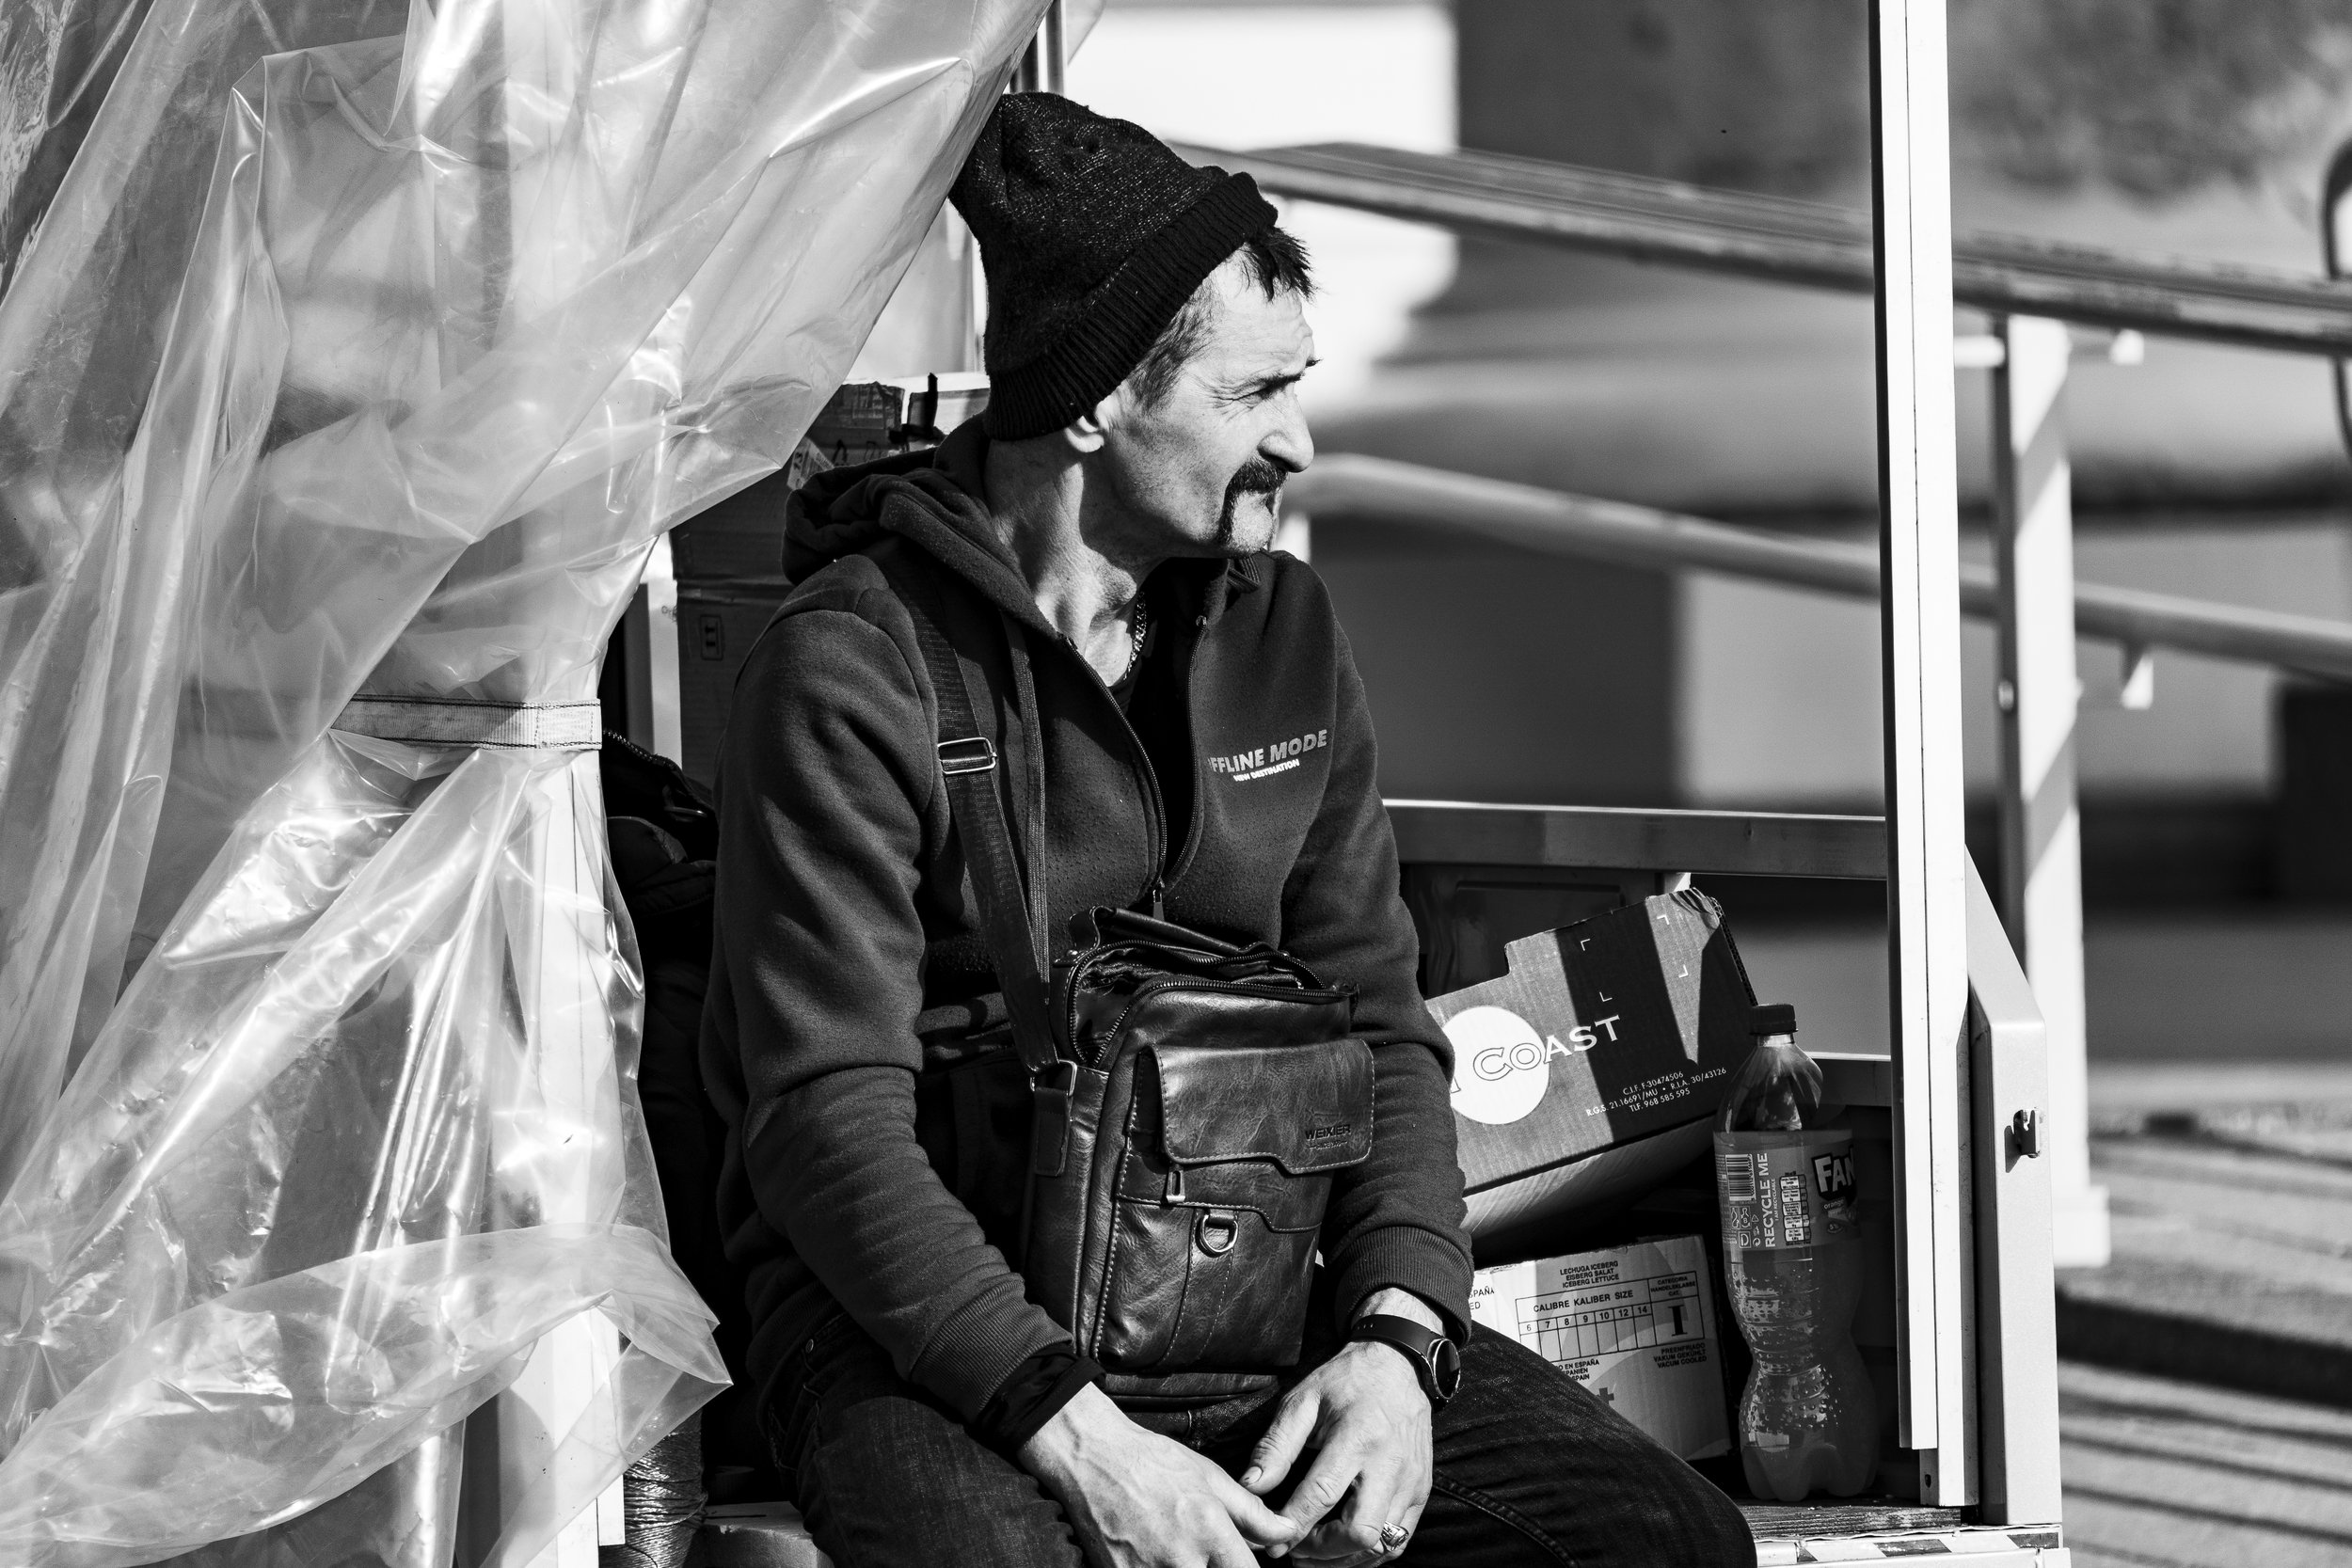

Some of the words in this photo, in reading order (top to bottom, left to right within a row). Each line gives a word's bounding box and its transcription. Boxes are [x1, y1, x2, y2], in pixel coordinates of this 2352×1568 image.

[1208, 749, 1264, 772] FFLINE
[1270, 730, 1327, 763] MODE
[1233, 773, 1250, 782] NEW
[1250, 758, 1300, 779] DESTINATION
[1472, 1015, 1620, 1081] COAST
[1691, 1067, 1726, 1083] 30/43126
[1623, 1085, 1641, 1096] C.I.F.
[1644, 1099, 1659, 1108] 968
[1661, 1093, 1675, 1102] 585
[1676, 1088, 1691, 1098] 595
[1757, 1153, 1769, 1176] ME
[1760, 1180, 1776, 1247] RECYCLE
[1560, 1265, 1590, 1275] LECHUGA
[1591, 1260, 1618, 1270] ICEBERG
[1566, 1272, 1593, 1280] EISBERG
[1594, 1268, 1614, 1276] SALAT
[1563, 1279, 1590, 1288] ICEBERG
[1591, 1274, 1619, 1283] LETTUCE
[1534, 1300, 1570, 1312] CALIBRE
[1574, 1293, 1611, 1306] KALIBER
[1614, 1290, 1633, 1300] SIZE
[1618, 1308, 1629, 1317] 12
[1638, 1306, 1647, 1314] 14
[1575, 1359, 1599, 1369] ESPAÑA
[1658, 1360, 1679, 1369] VACUM
[1681, 1355, 1707, 1365] COOLED
